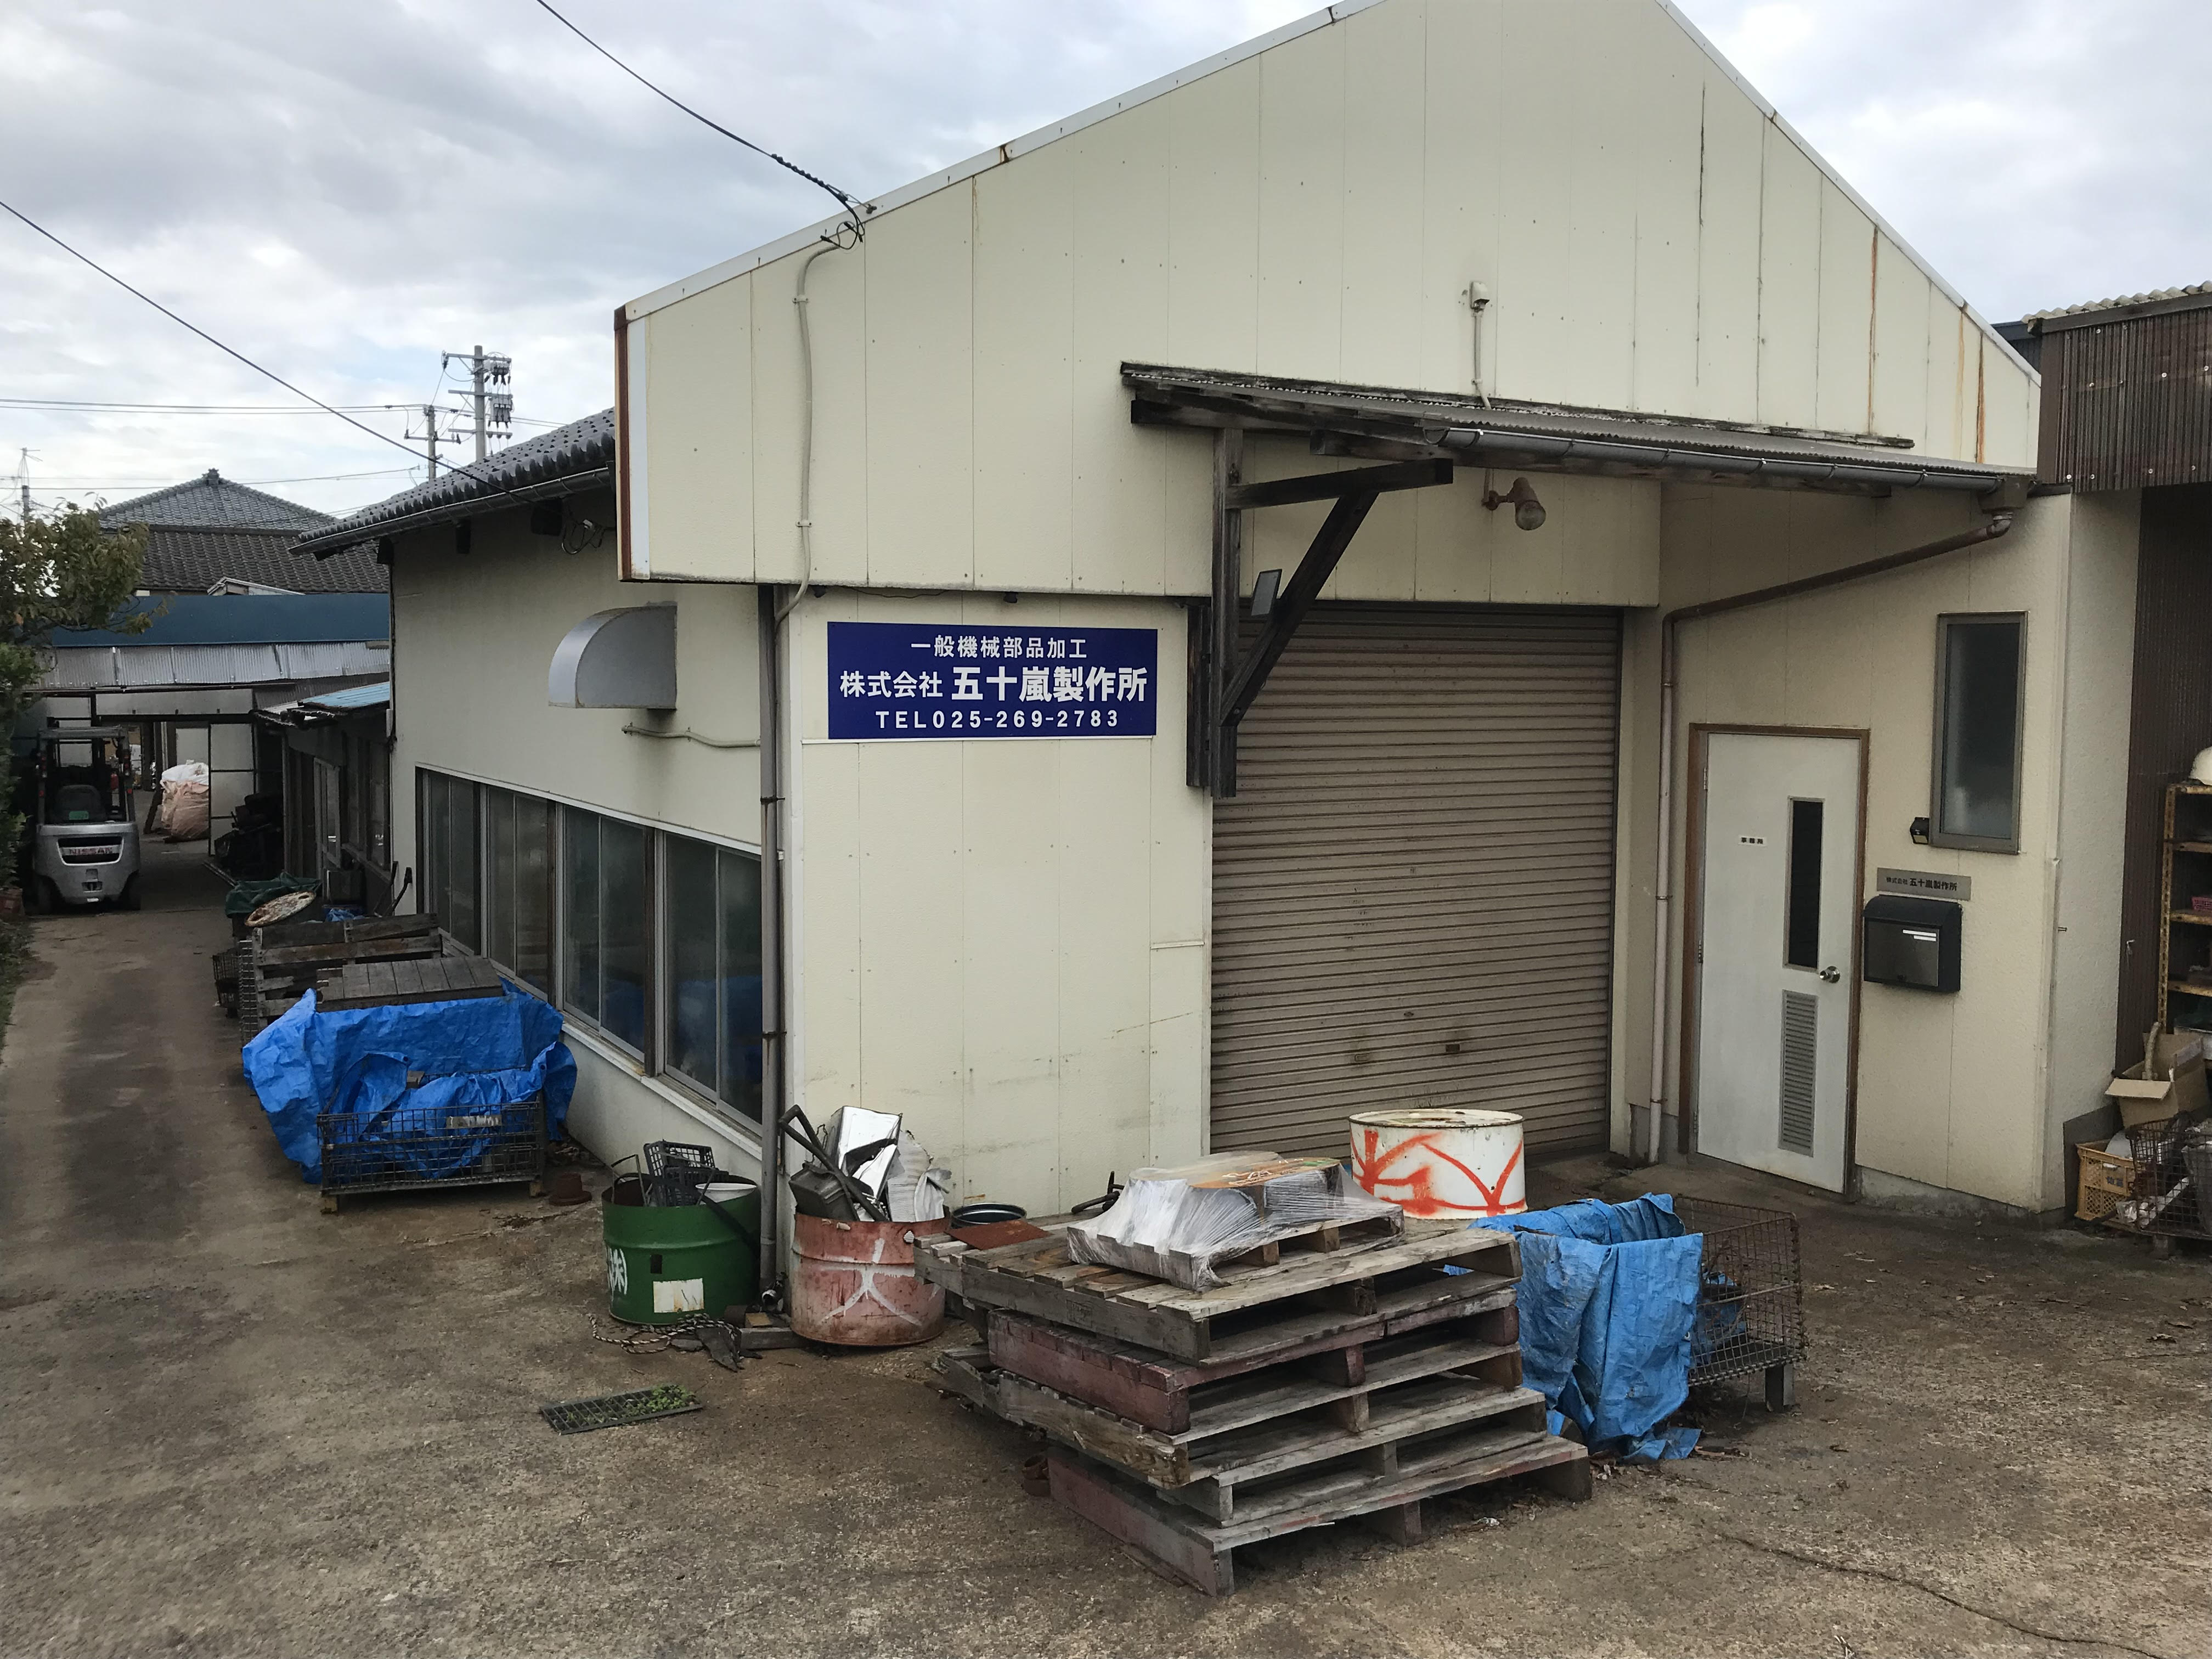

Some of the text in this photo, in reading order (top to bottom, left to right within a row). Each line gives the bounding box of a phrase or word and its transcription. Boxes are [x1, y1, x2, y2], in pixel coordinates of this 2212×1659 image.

[911, 635, 1087, 659] 一般機械部品加工
[840, 665, 1148, 703] 株式会社 五十嵐製作所
[69, 847, 113, 855] NISSAN
